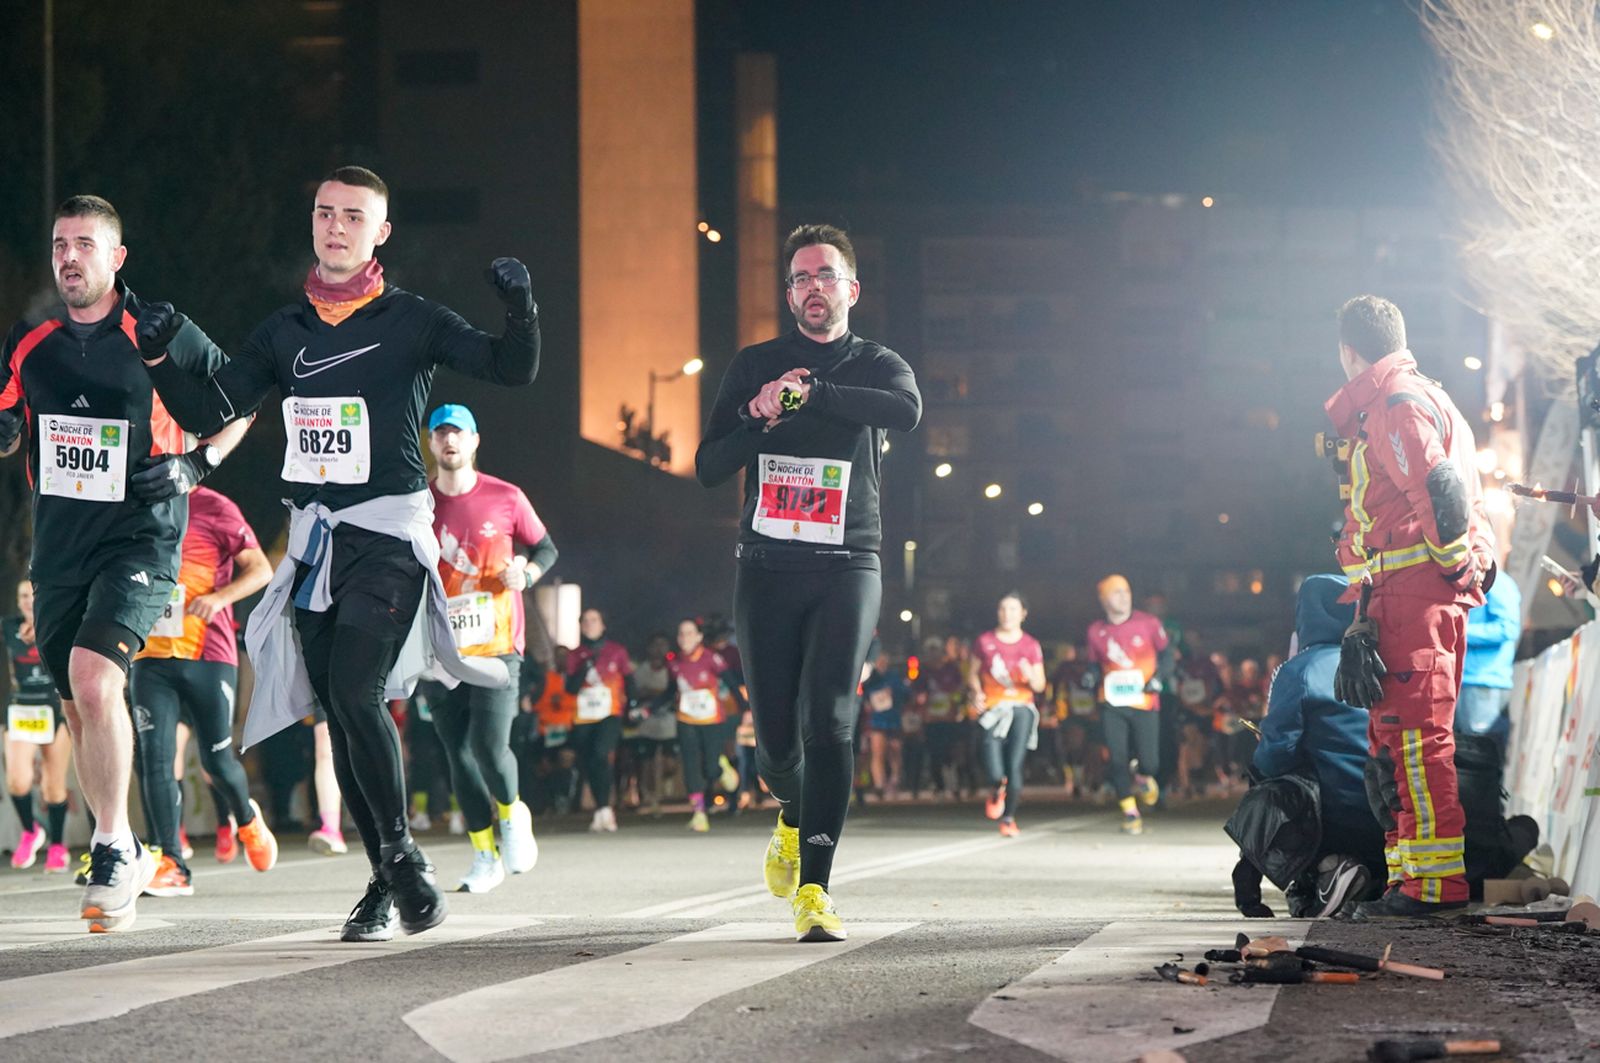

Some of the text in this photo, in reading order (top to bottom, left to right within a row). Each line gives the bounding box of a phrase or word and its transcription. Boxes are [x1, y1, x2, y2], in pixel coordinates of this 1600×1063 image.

[300, 408, 319, 416] NOCHE
[321, 408, 332, 416] DE
[294, 417, 306, 426] SAN
[59, 425, 82, 435] NOCHE
[83, 427, 93, 435] DE
[50, 433, 65, 442] SAN
[299, 428, 352, 454] 6829
[56, 445, 109, 472] 5904
[777, 465, 802, 474] NOCHE
[804, 467, 815, 475] DE
[768, 474, 784, 483] SAN
[776, 485, 827, 513] 9791
